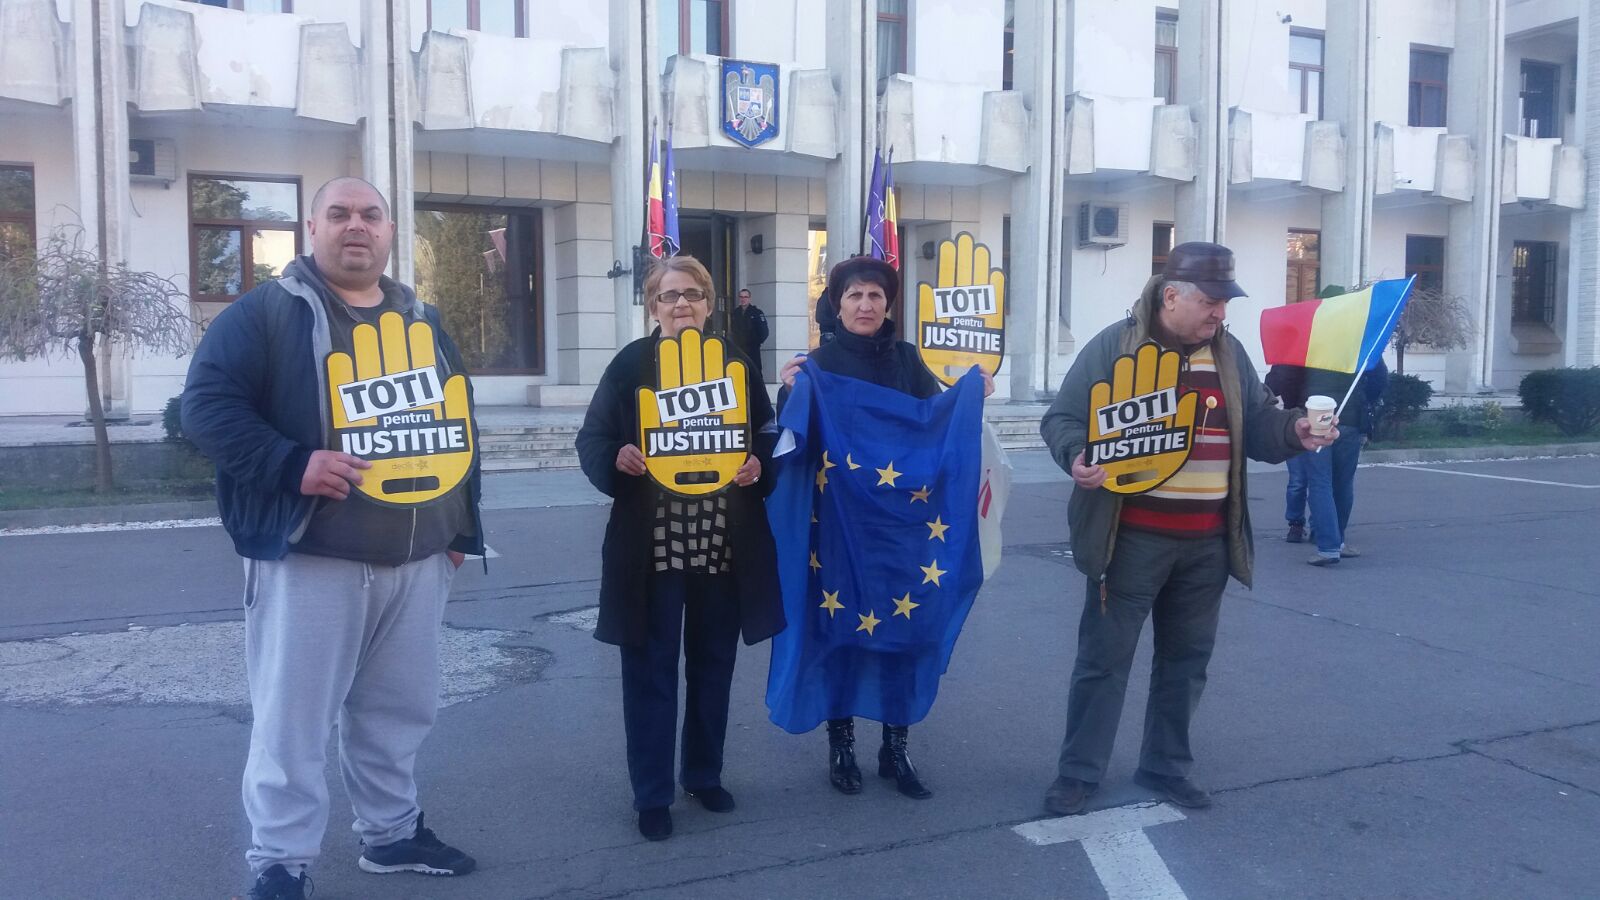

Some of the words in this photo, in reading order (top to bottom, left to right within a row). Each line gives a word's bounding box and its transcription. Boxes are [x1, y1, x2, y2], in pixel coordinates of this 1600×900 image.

[935, 288, 990, 314] TOȚI
[953, 317, 982, 327] pentru
[924, 326, 1000, 352] JUSTIȚIE
[343, 372, 433, 414] TOȚI
[659, 382, 729, 416] TOȚI
[383, 412, 430, 427] pentru
[682, 417, 720, 429] pentru
[1099, 392, 1168, 430] TOȚI
[649, 430, 745, 456] JUSTIȚIE
[1125, 424, 1162, 438] pentru
[1090, 431, 1185, 465] JUSTIȚIE
